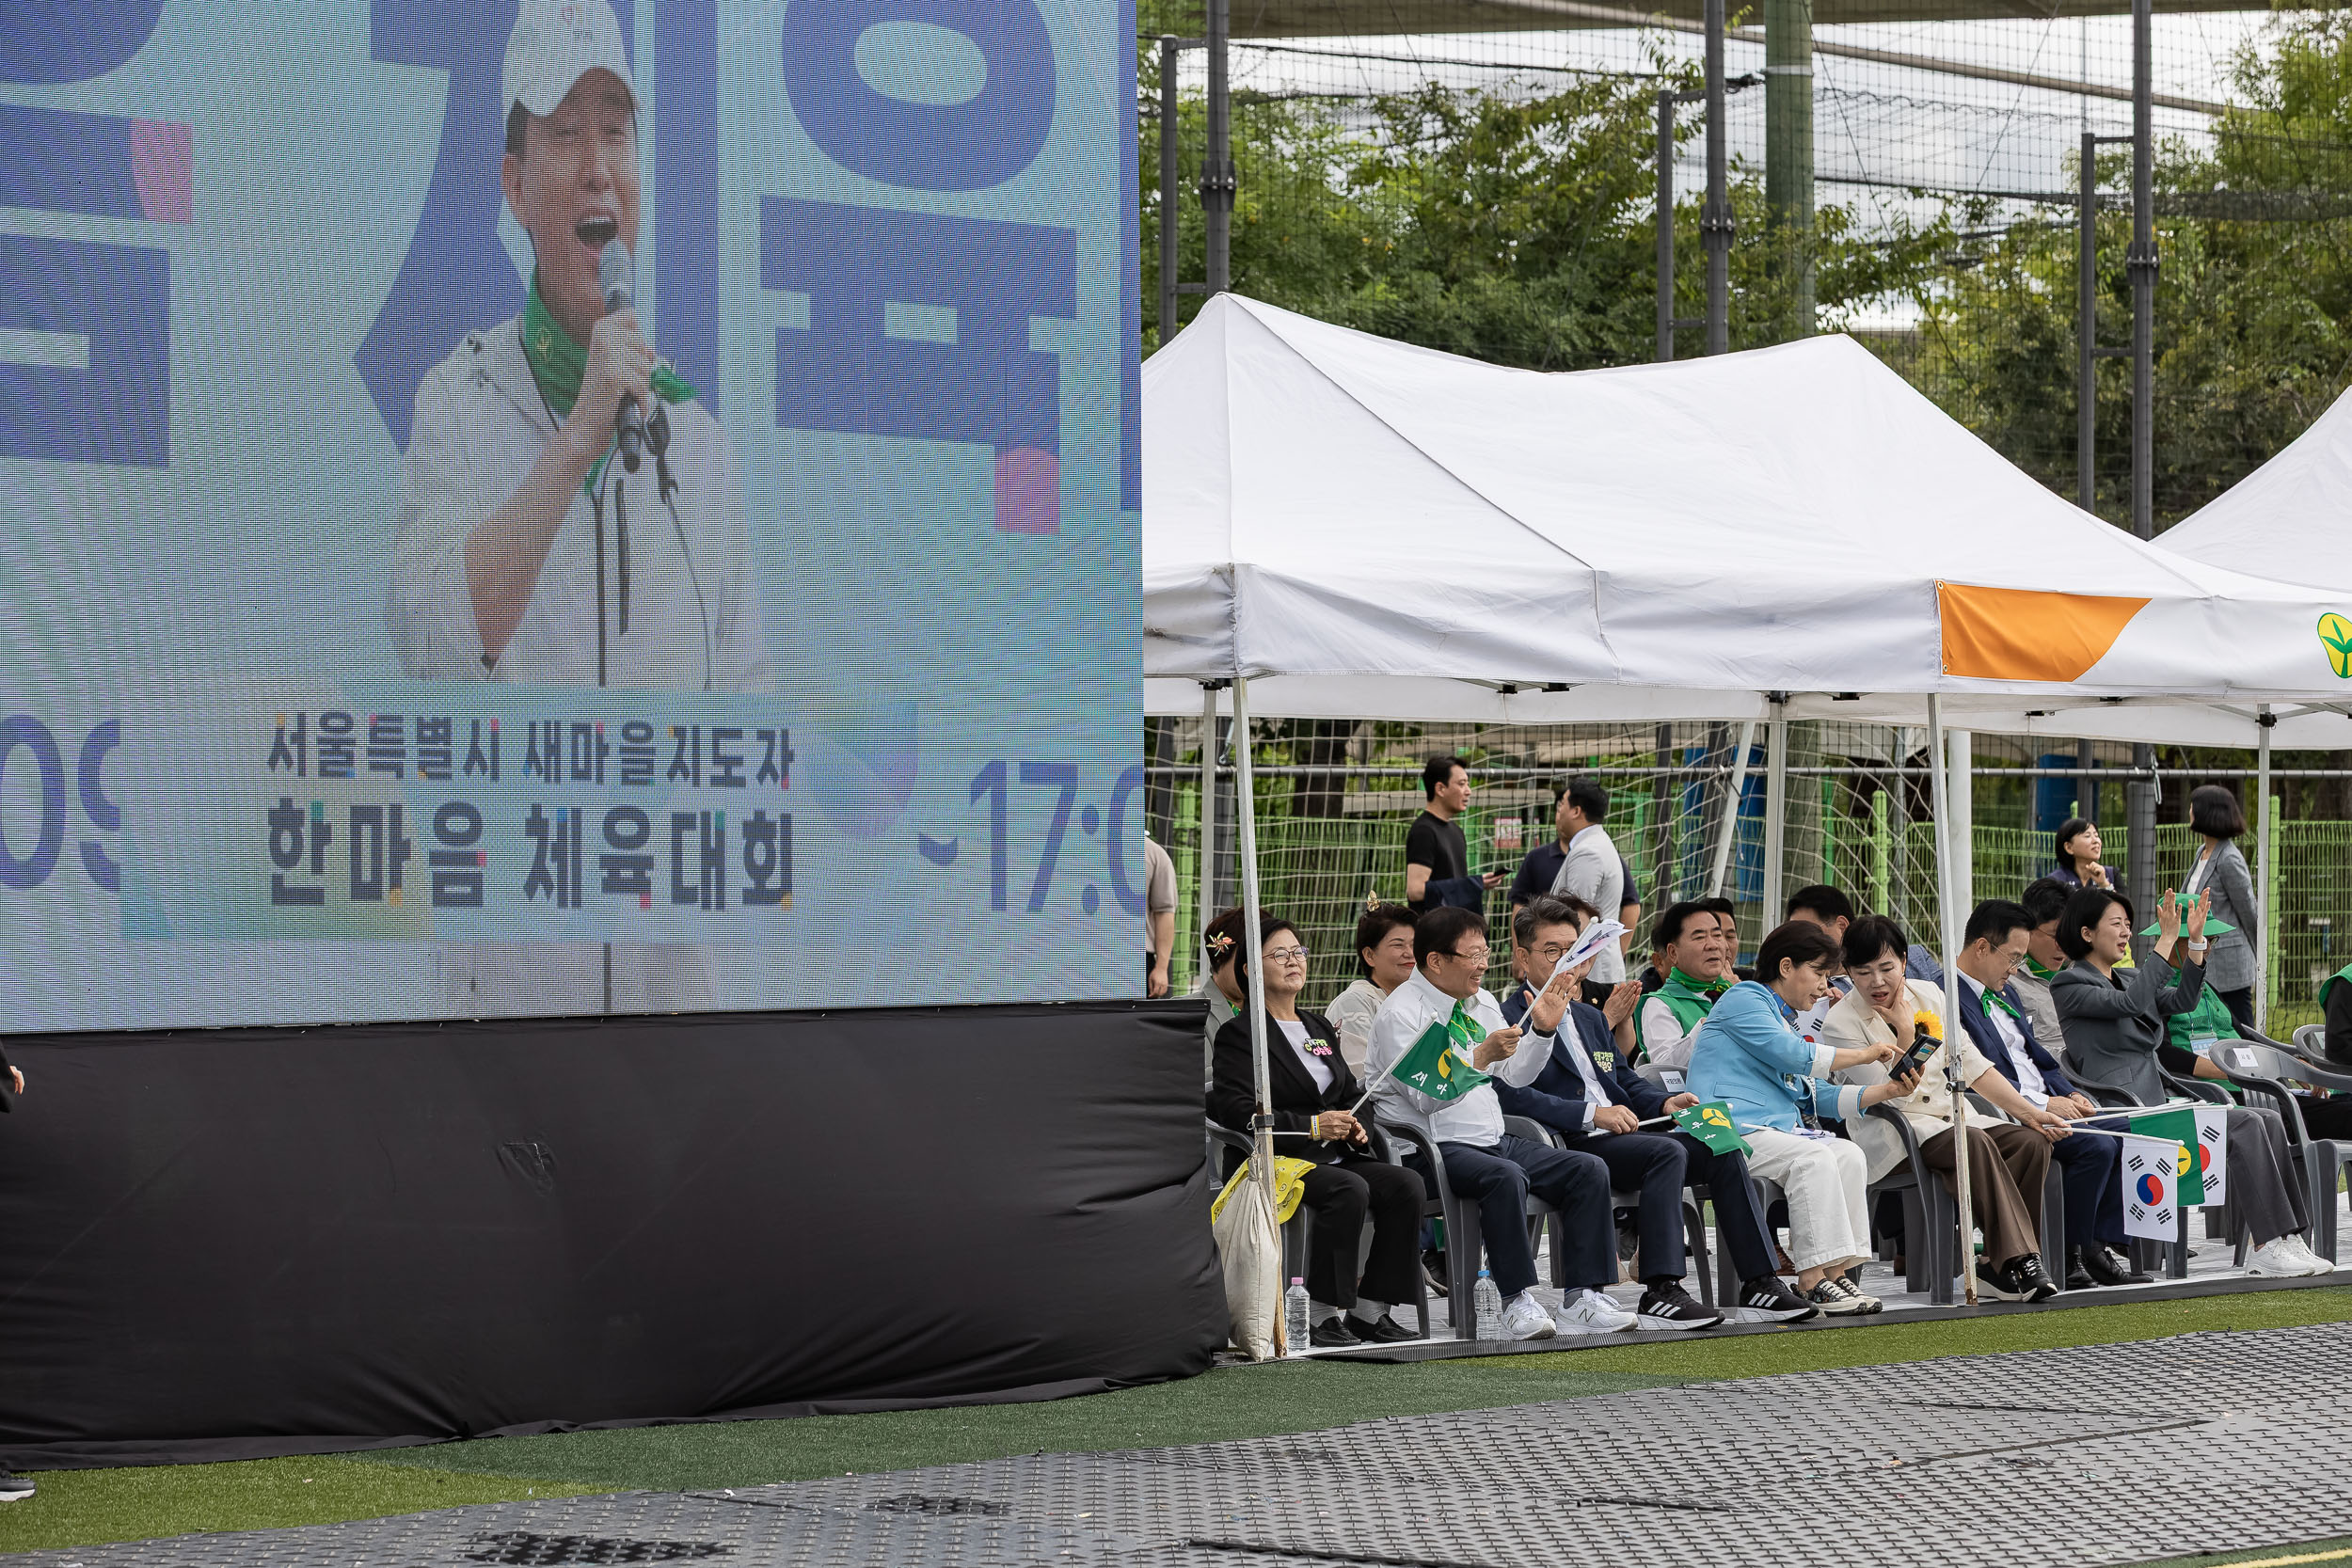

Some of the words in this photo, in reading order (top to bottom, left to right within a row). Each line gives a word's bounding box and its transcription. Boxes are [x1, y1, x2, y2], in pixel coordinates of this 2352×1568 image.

[267, 710, 501, 783] 서울특별시
[524, 720, 793, 790] 새마을지도자
[267, 798, 486, 909] 한마음
[524, 801, 793, 911] 체육대회
[1411, 1070, 1448, 1095] 새마
